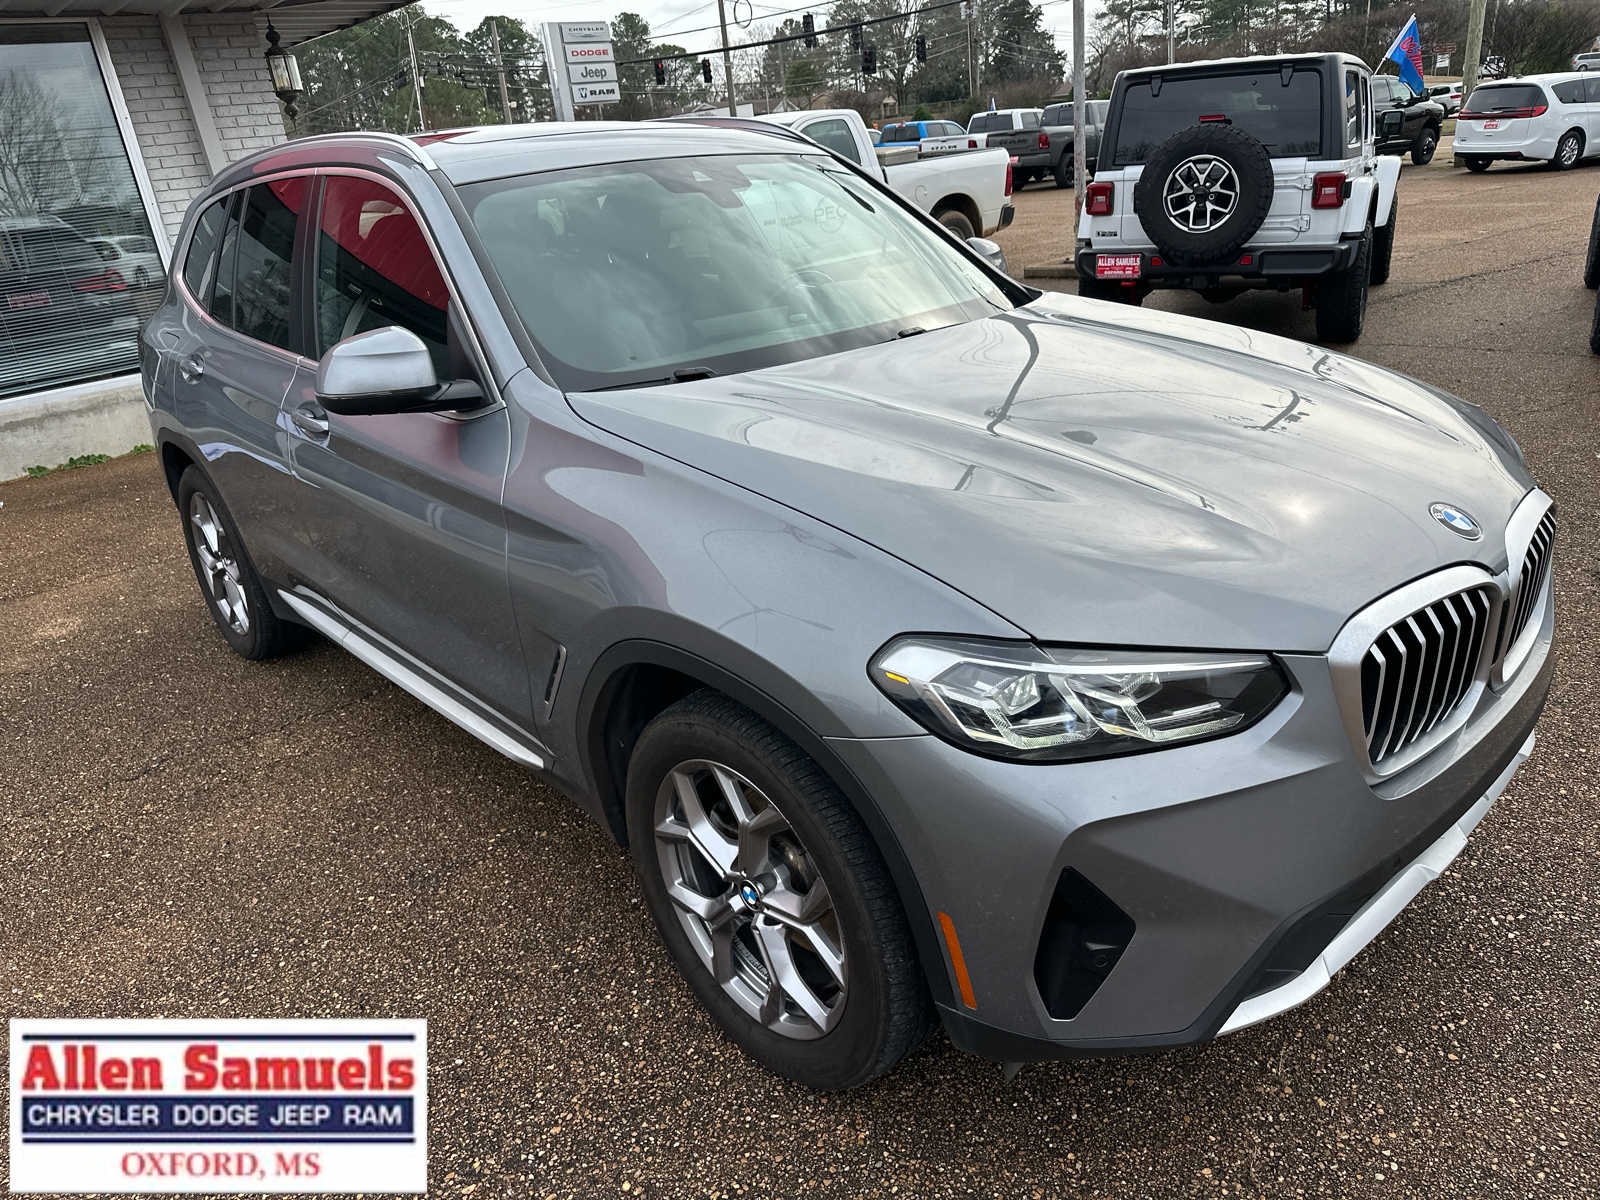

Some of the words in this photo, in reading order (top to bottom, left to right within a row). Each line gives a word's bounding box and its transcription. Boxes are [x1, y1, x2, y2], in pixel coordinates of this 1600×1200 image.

[571, 49, 609, 57] DODGE
[581, 66, 607, 79] Jeep
[589, 88, 615, 96] RAM
